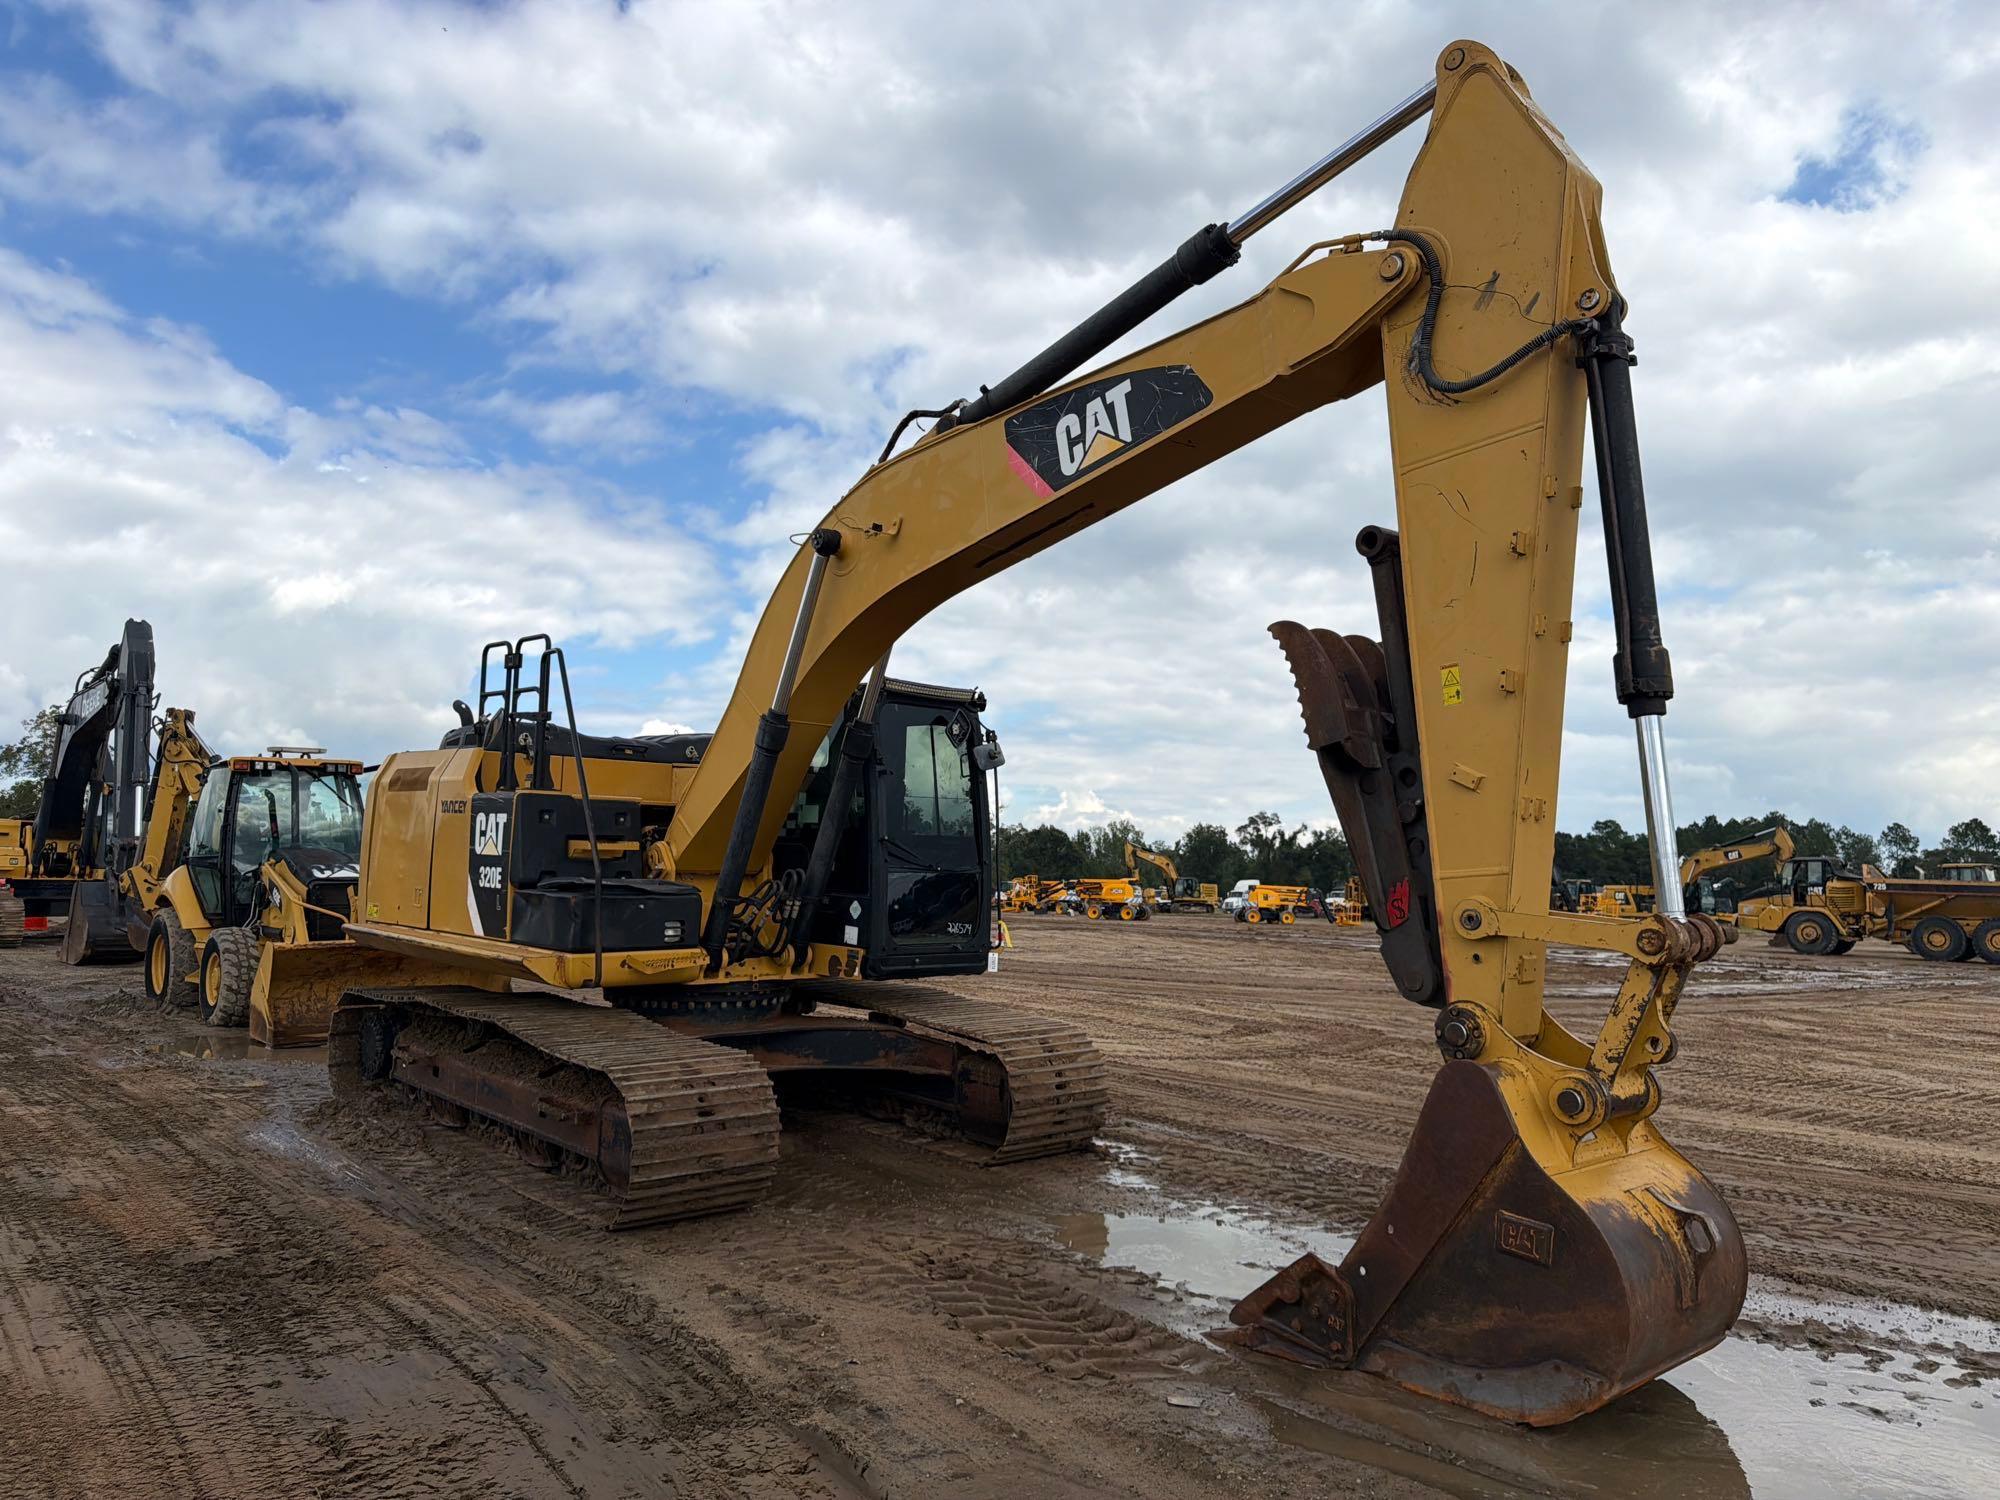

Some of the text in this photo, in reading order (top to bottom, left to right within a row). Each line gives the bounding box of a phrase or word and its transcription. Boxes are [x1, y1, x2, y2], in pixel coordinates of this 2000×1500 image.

[1055, 378, 1132, 476] CAT
[441, 800, 467, 814] YANCEY
[474, 812, 507, 856] CAT
[1728, 851, 1738, 860] CAT
[479, 866, 502, 889] 320E
[1807, 886, 1823, 896] CAT
[1501, 1221, 1543, 1259] CAT
